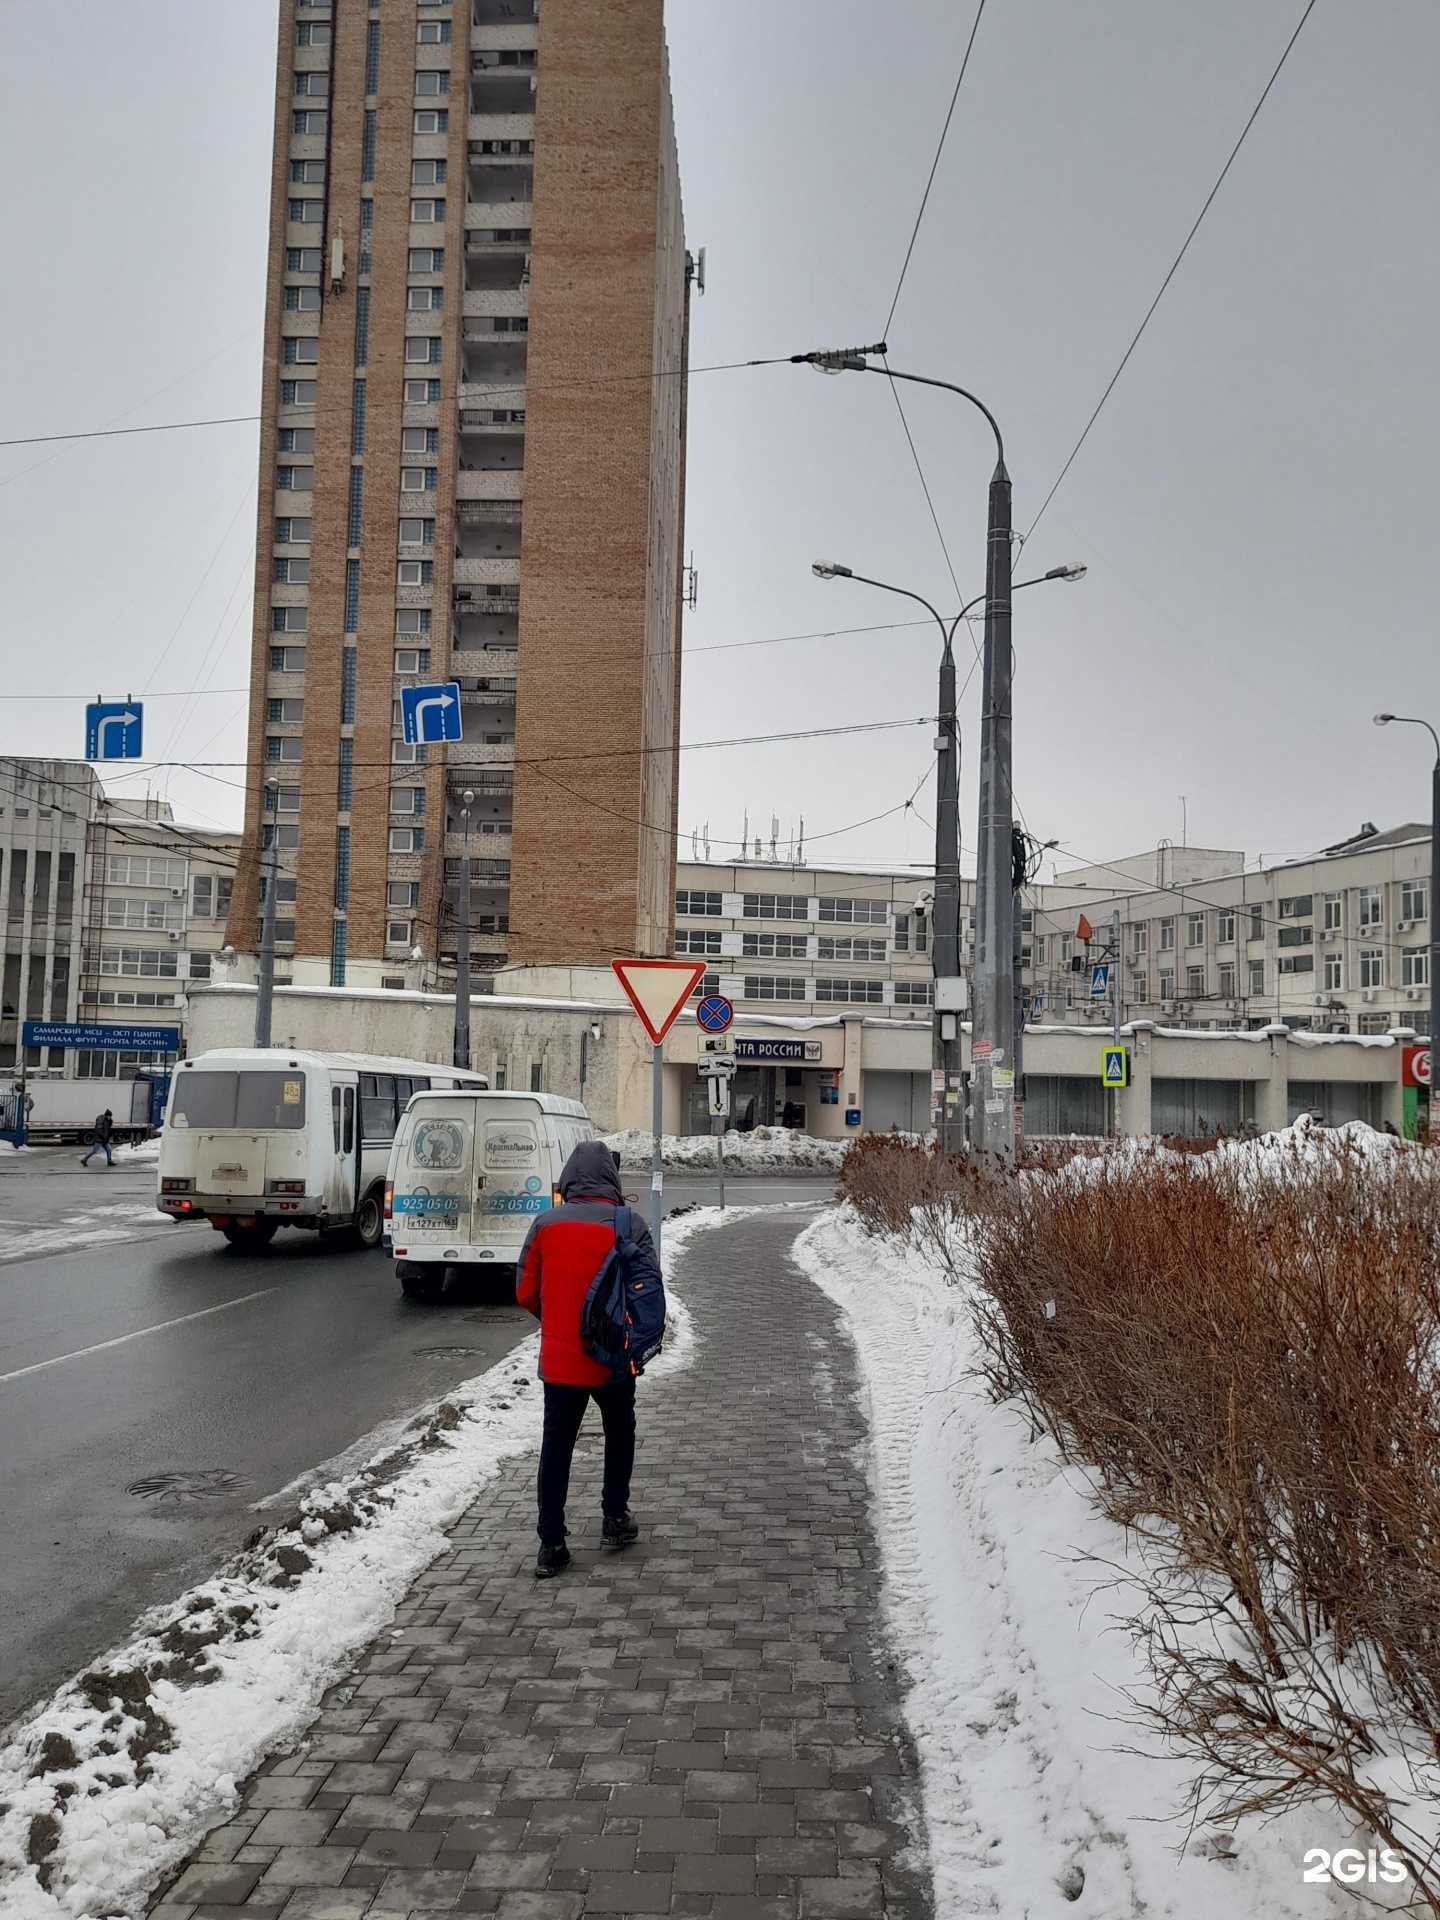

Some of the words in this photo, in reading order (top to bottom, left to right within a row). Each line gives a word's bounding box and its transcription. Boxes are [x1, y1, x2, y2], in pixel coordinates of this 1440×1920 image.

[32, 1026, 81, 1035] САМАРСКИЙ
[113, 1029, 130, 1037] ОСП
[32, 1034, 72, 1043] ФИЛИАЛА
[75, 1036, 97, 1044] ФГУП
[735, 1042, 755, 1055] ЧТА
[758, 1043, 802, 1057] РОССИИ
[402, 1198, 423, 1210] 925
[427, 1199, 440, 1210] 05
[444, 1200, 458, 1210] 05
[508, 1199, 523, 1210] 05
[526, 1199, 541, 1210] 05
